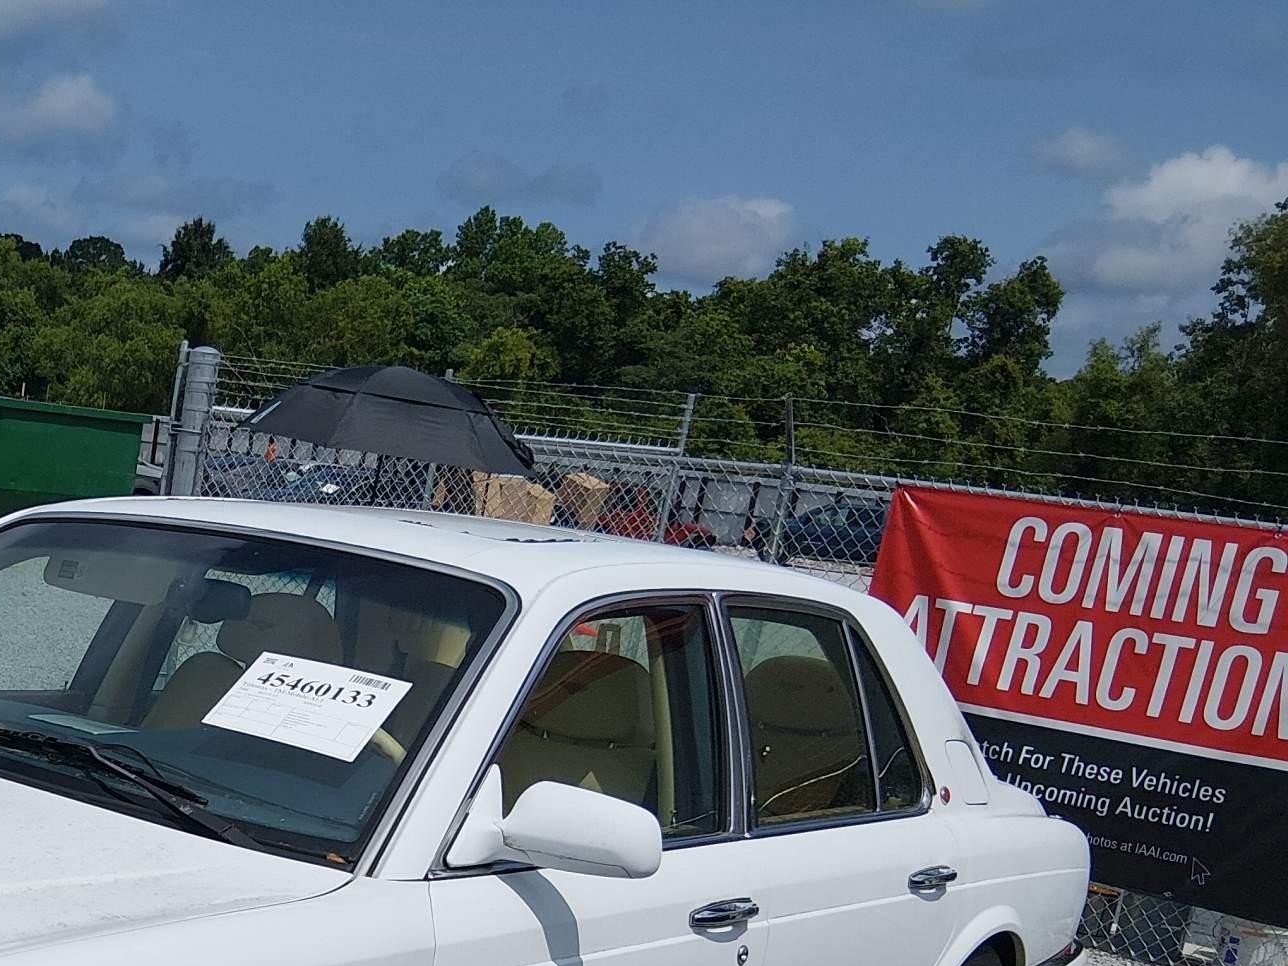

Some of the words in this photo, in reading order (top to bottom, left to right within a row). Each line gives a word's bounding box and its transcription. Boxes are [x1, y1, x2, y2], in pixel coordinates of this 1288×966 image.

[997, 516, 1288, 634] COMING
[257, 671, 376, 708] 45460133
[1018, 745, 1054, 770] For
[1060, 753, 1123, 784] These
[1132, 766, 1226, 803] Vehicles
[1114, 796, 1214, 832] Auction!
[1119, 842, 1133, 853] at
[1134, 843, 1188, 864] IAAI.com
